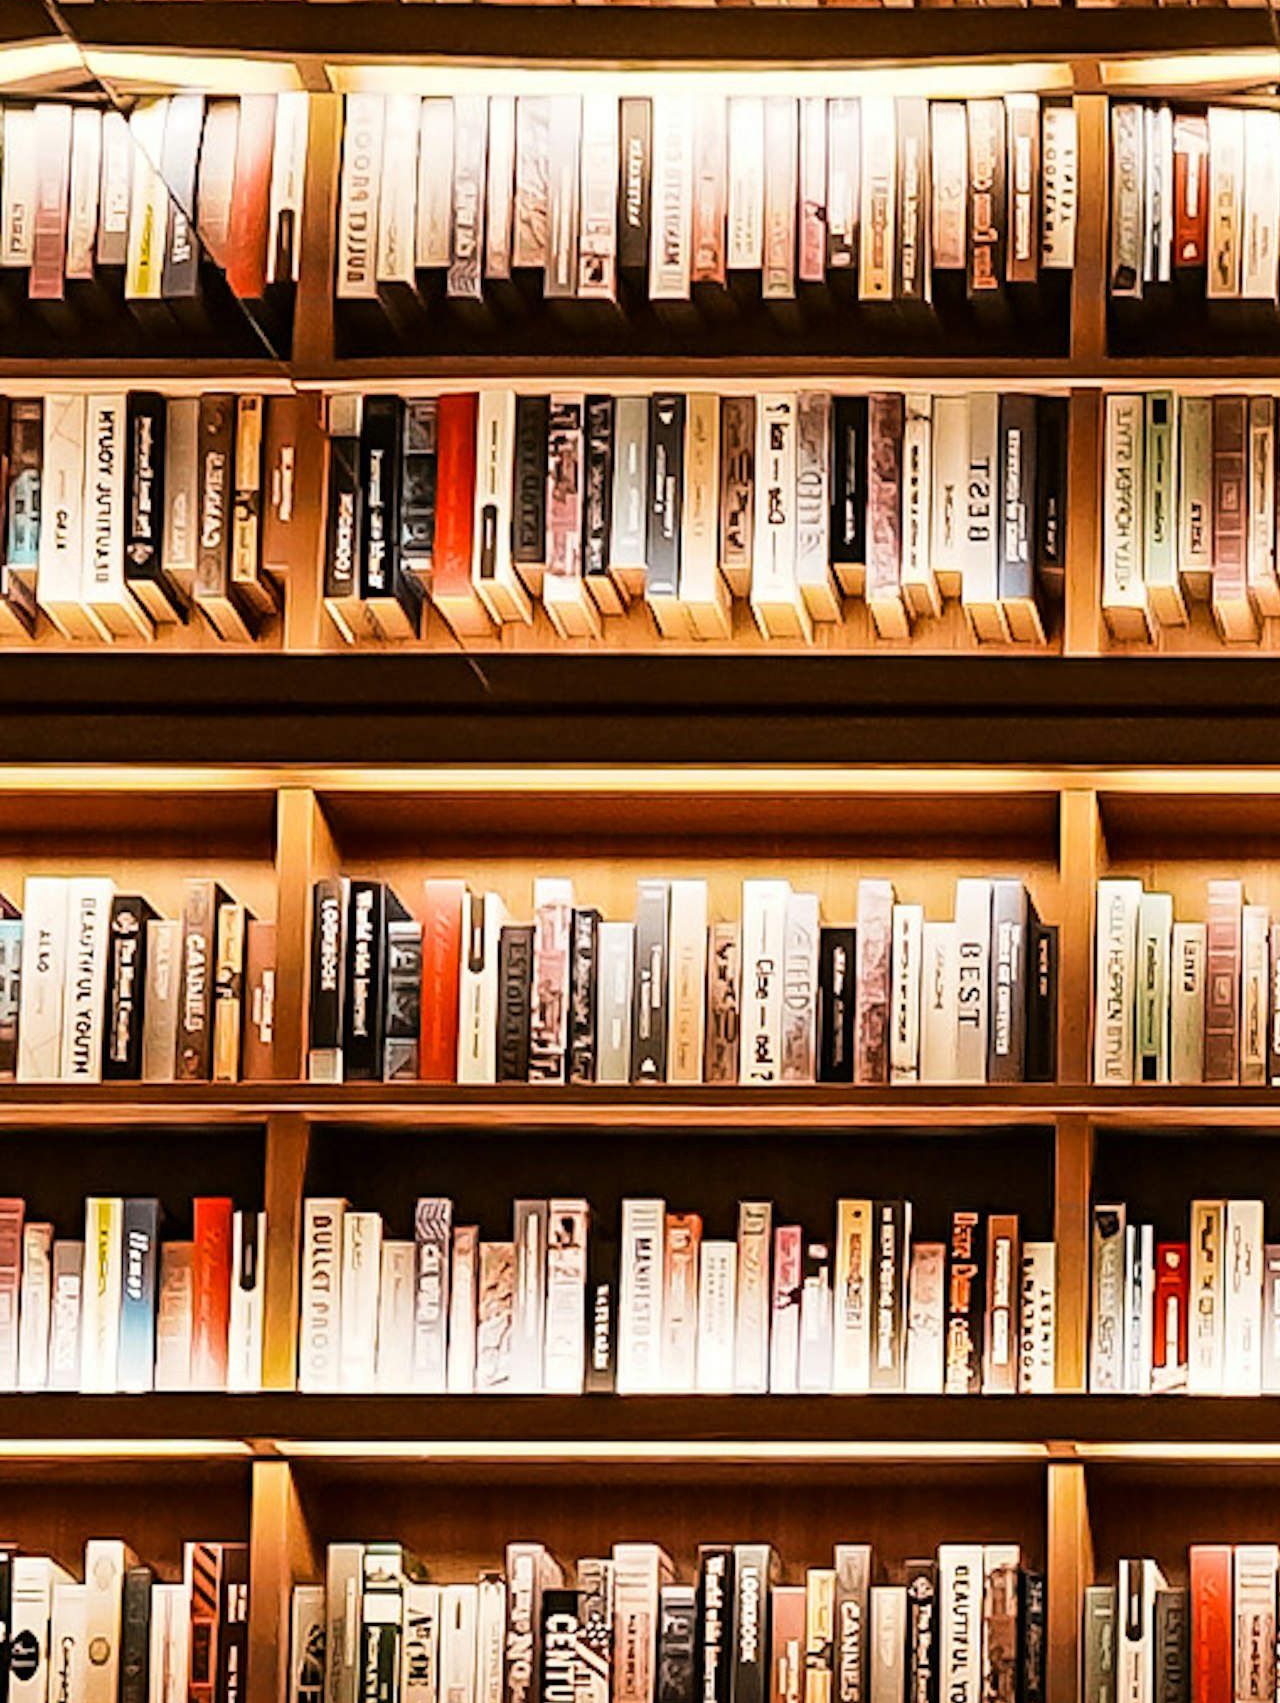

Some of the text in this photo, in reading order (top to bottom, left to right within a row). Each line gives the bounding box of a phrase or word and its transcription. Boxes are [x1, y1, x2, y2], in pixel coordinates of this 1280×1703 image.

[958, 942, 981, 1028] BEST
[72, 1009, 92, 1073] YOUTH
[312, 1215, 333, 1294] BULLET
[706, 1556, 725, 1605] World
[951, 1566, 970, 1673] BEAUTIFUL
[839, 1601, 860, 1702] CANNES
